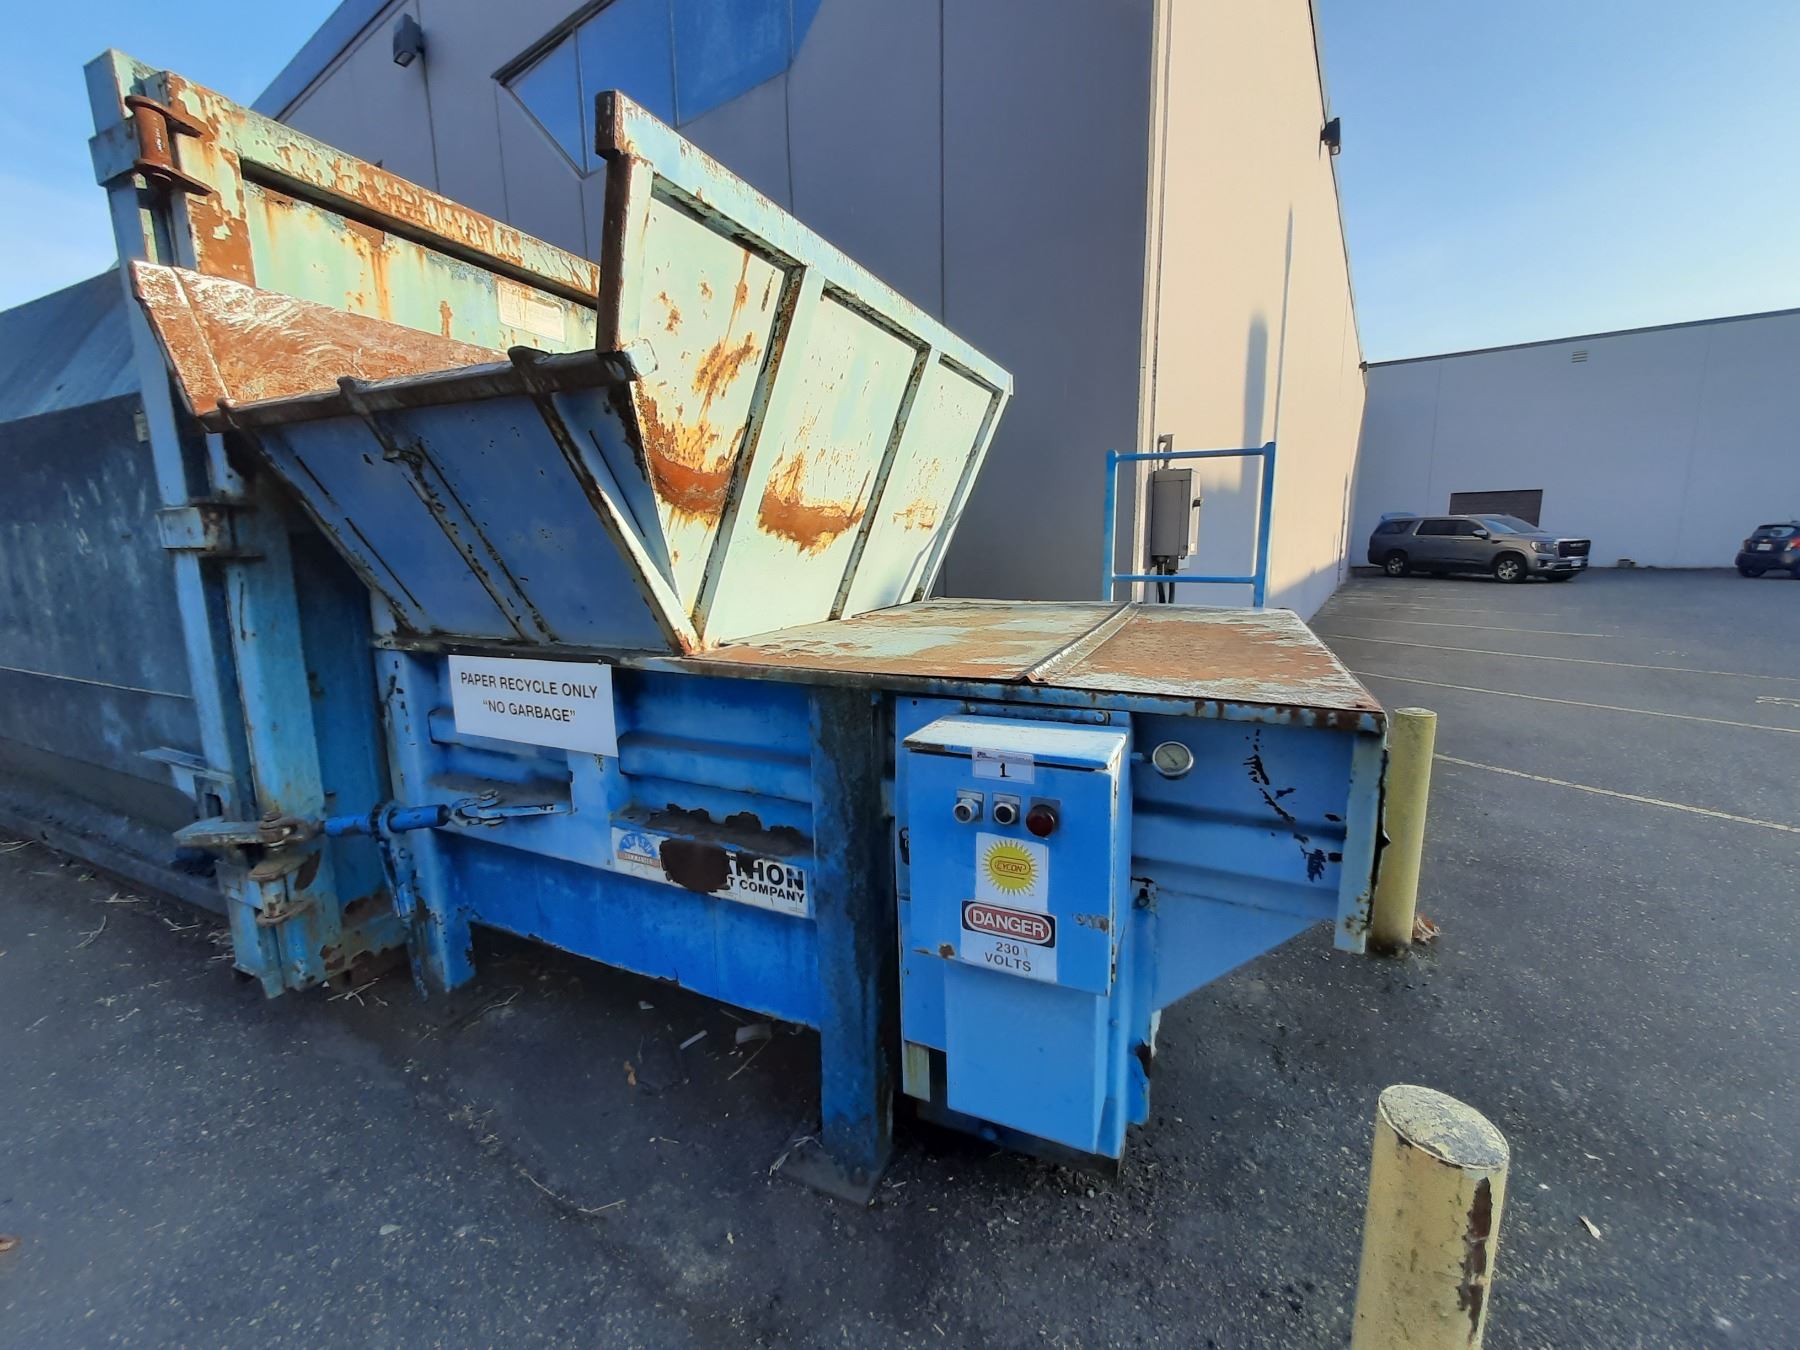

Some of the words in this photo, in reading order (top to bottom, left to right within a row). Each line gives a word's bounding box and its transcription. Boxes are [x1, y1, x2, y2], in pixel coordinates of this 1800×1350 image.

[461, 672, 496, 688] PAPER
[500, 677, 557, 695] RECYCLE
[562, 683, 597, 699] ONLY
[1000, 762, 1012, 778] 1
[739, 879, 805, 903] COMPANY
[972, 909, 1045, 938] DANGER
[996, 942, 1019, 956] 230
[985, 952, 1032, 972] VOLTS
